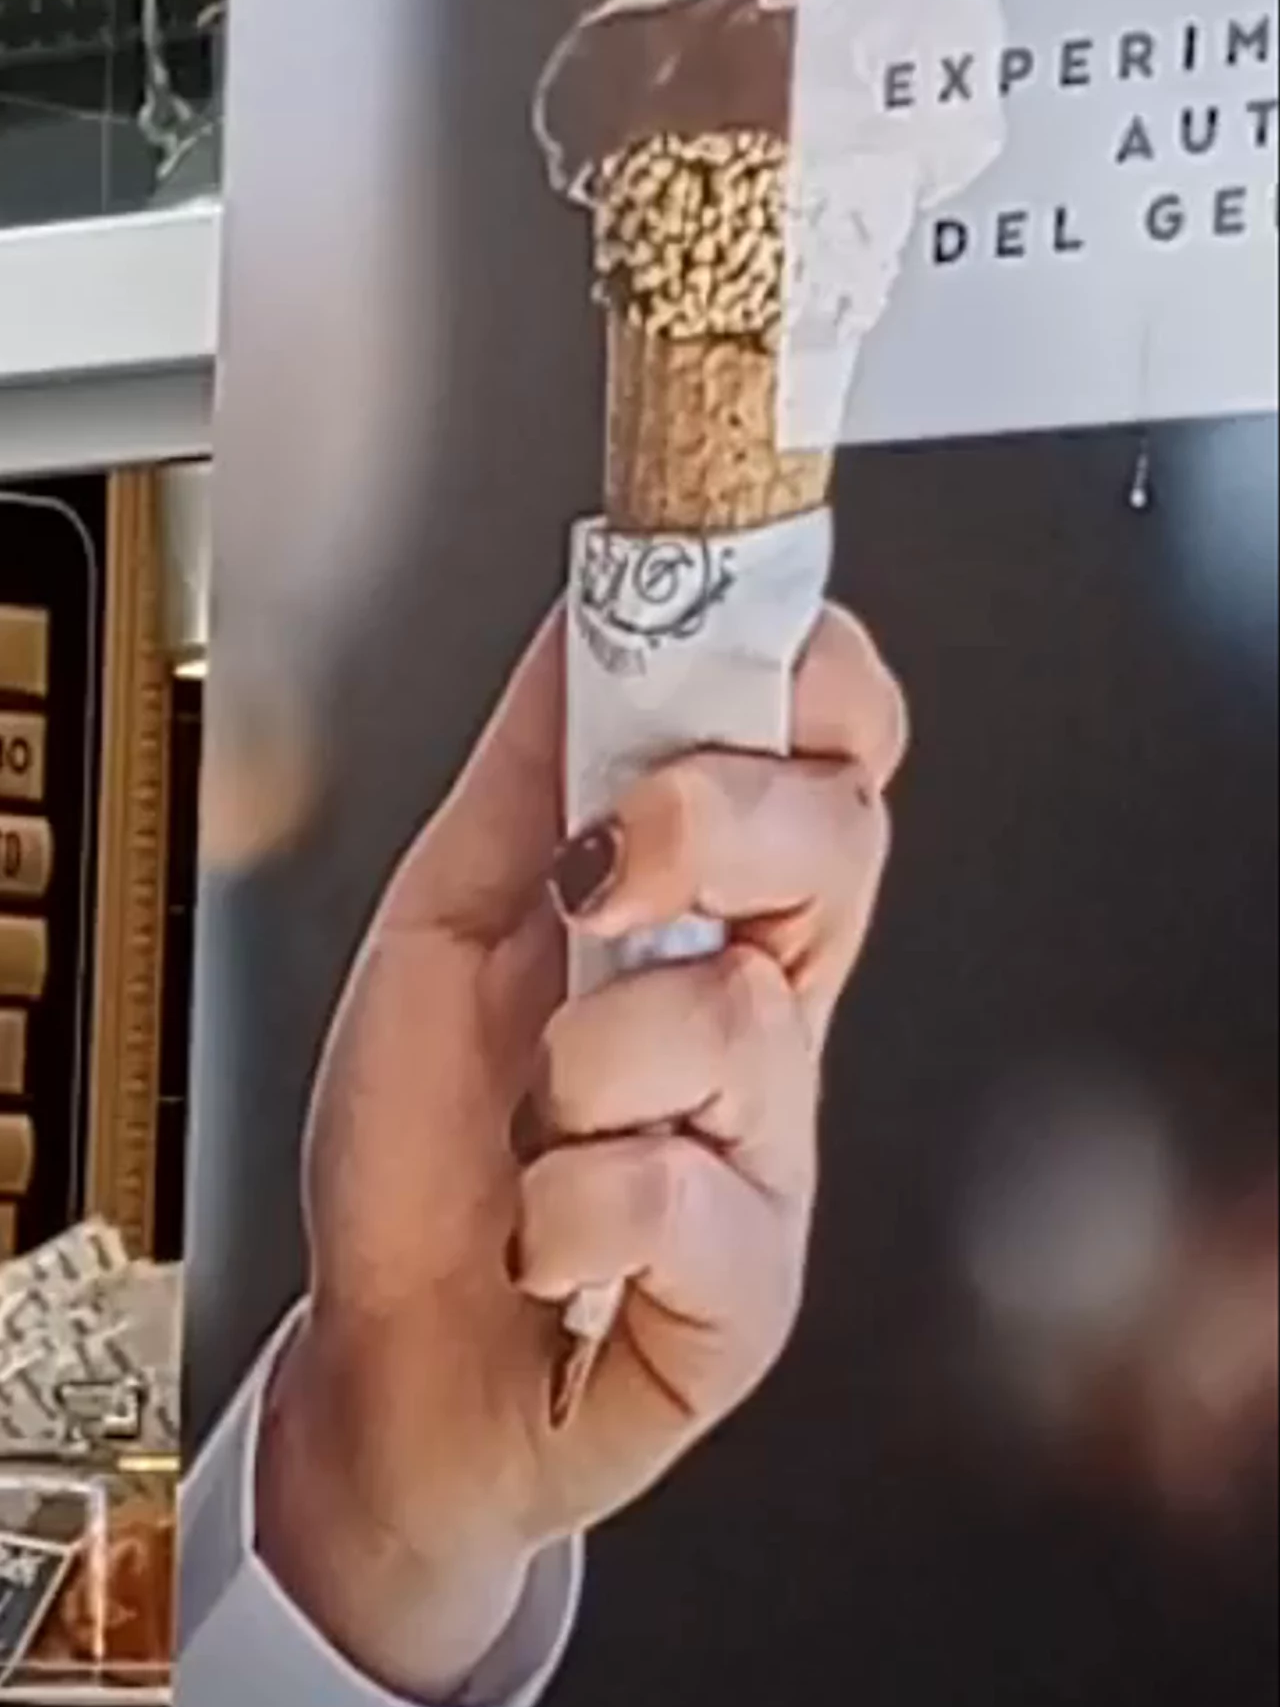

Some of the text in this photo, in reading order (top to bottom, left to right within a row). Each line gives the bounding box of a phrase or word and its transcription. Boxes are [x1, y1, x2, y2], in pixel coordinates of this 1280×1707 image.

[883, 15, 1271, 111] EXPERIM
[931, 187, 1278, 265] DEL GE
